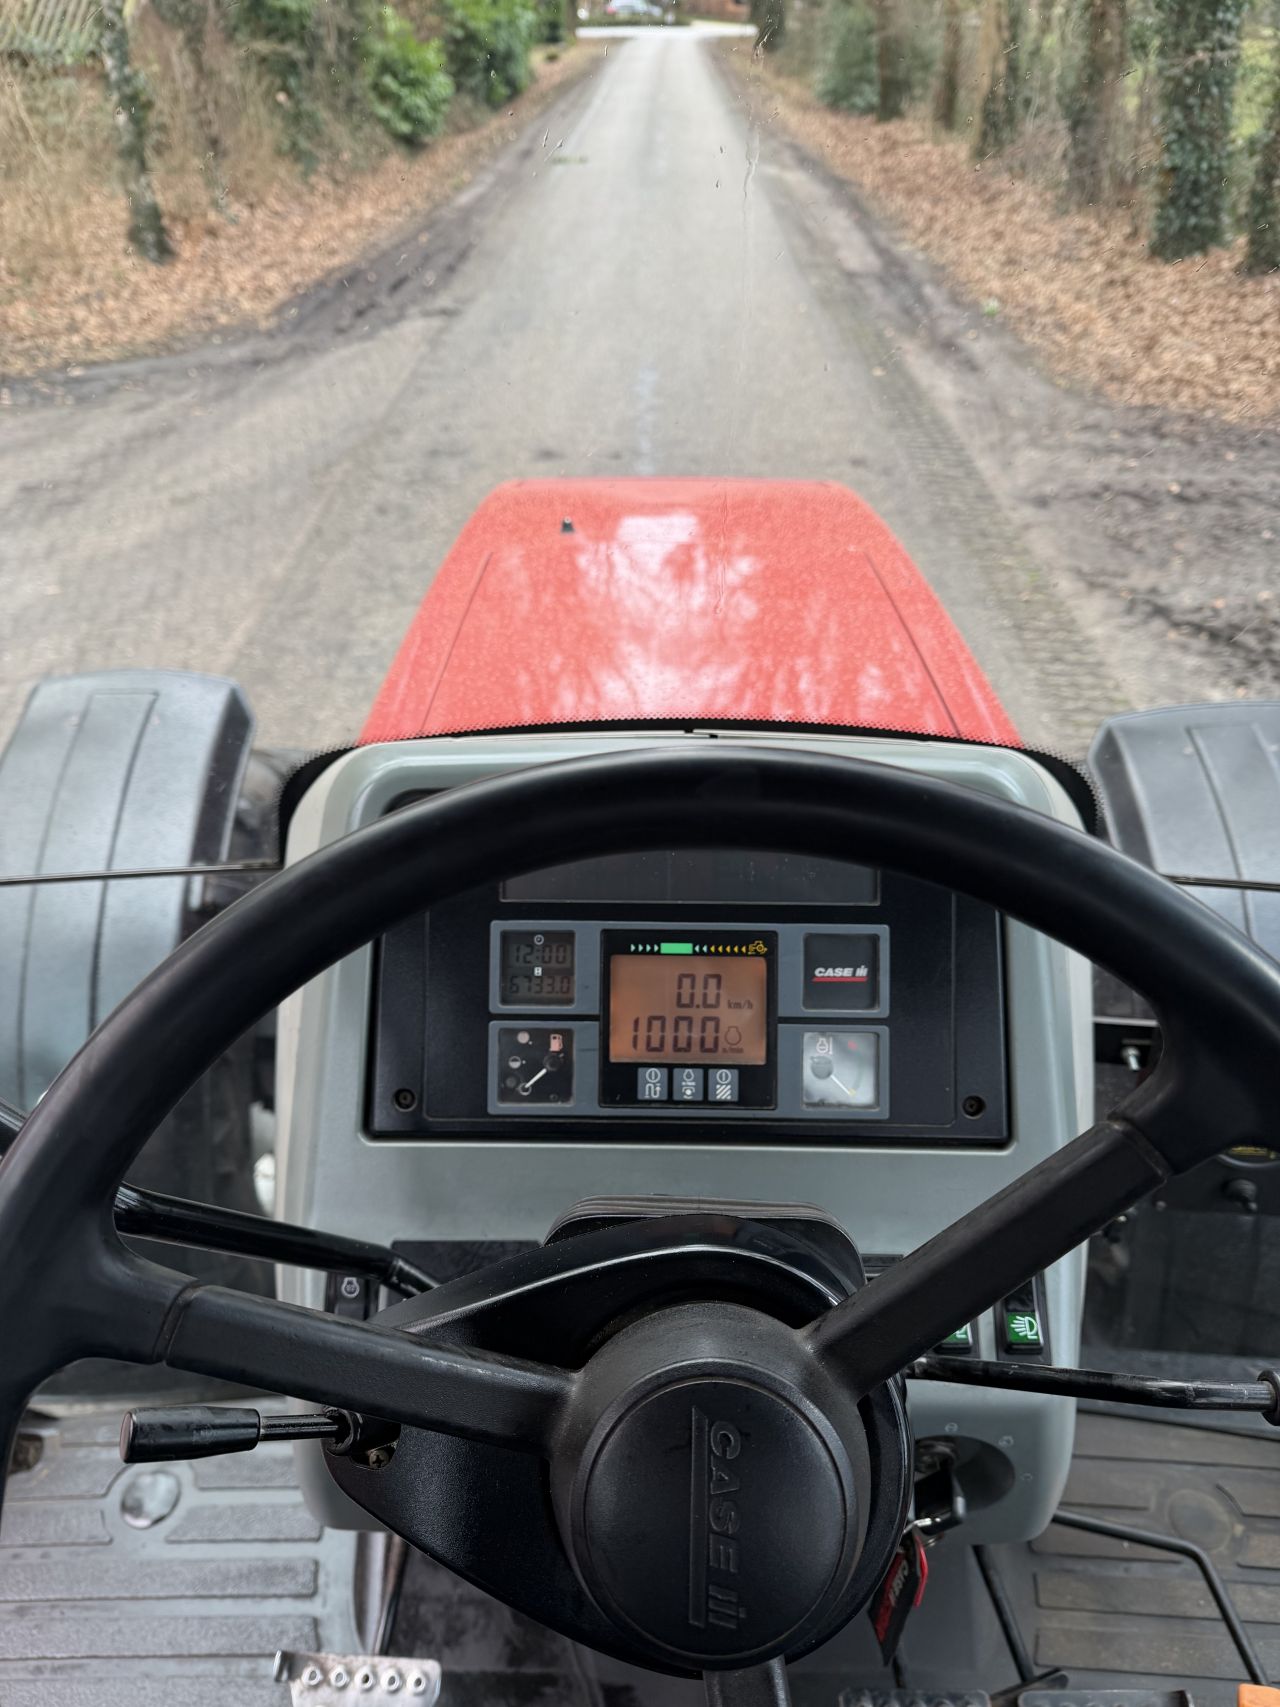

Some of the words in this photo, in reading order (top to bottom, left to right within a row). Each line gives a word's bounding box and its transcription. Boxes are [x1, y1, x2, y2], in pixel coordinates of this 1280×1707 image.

[515, 944, 567, 965] 12:00
[509, 975, 570, 995] 6733.0
[814, 967, 854, 977] CASE
[676, 973, 722, 1009] 0.0
[728, 1000, 754, 1010] km/h
[632, 1015, 720, 1053] 1000
[709, 1420, 742, 1573] CASE
